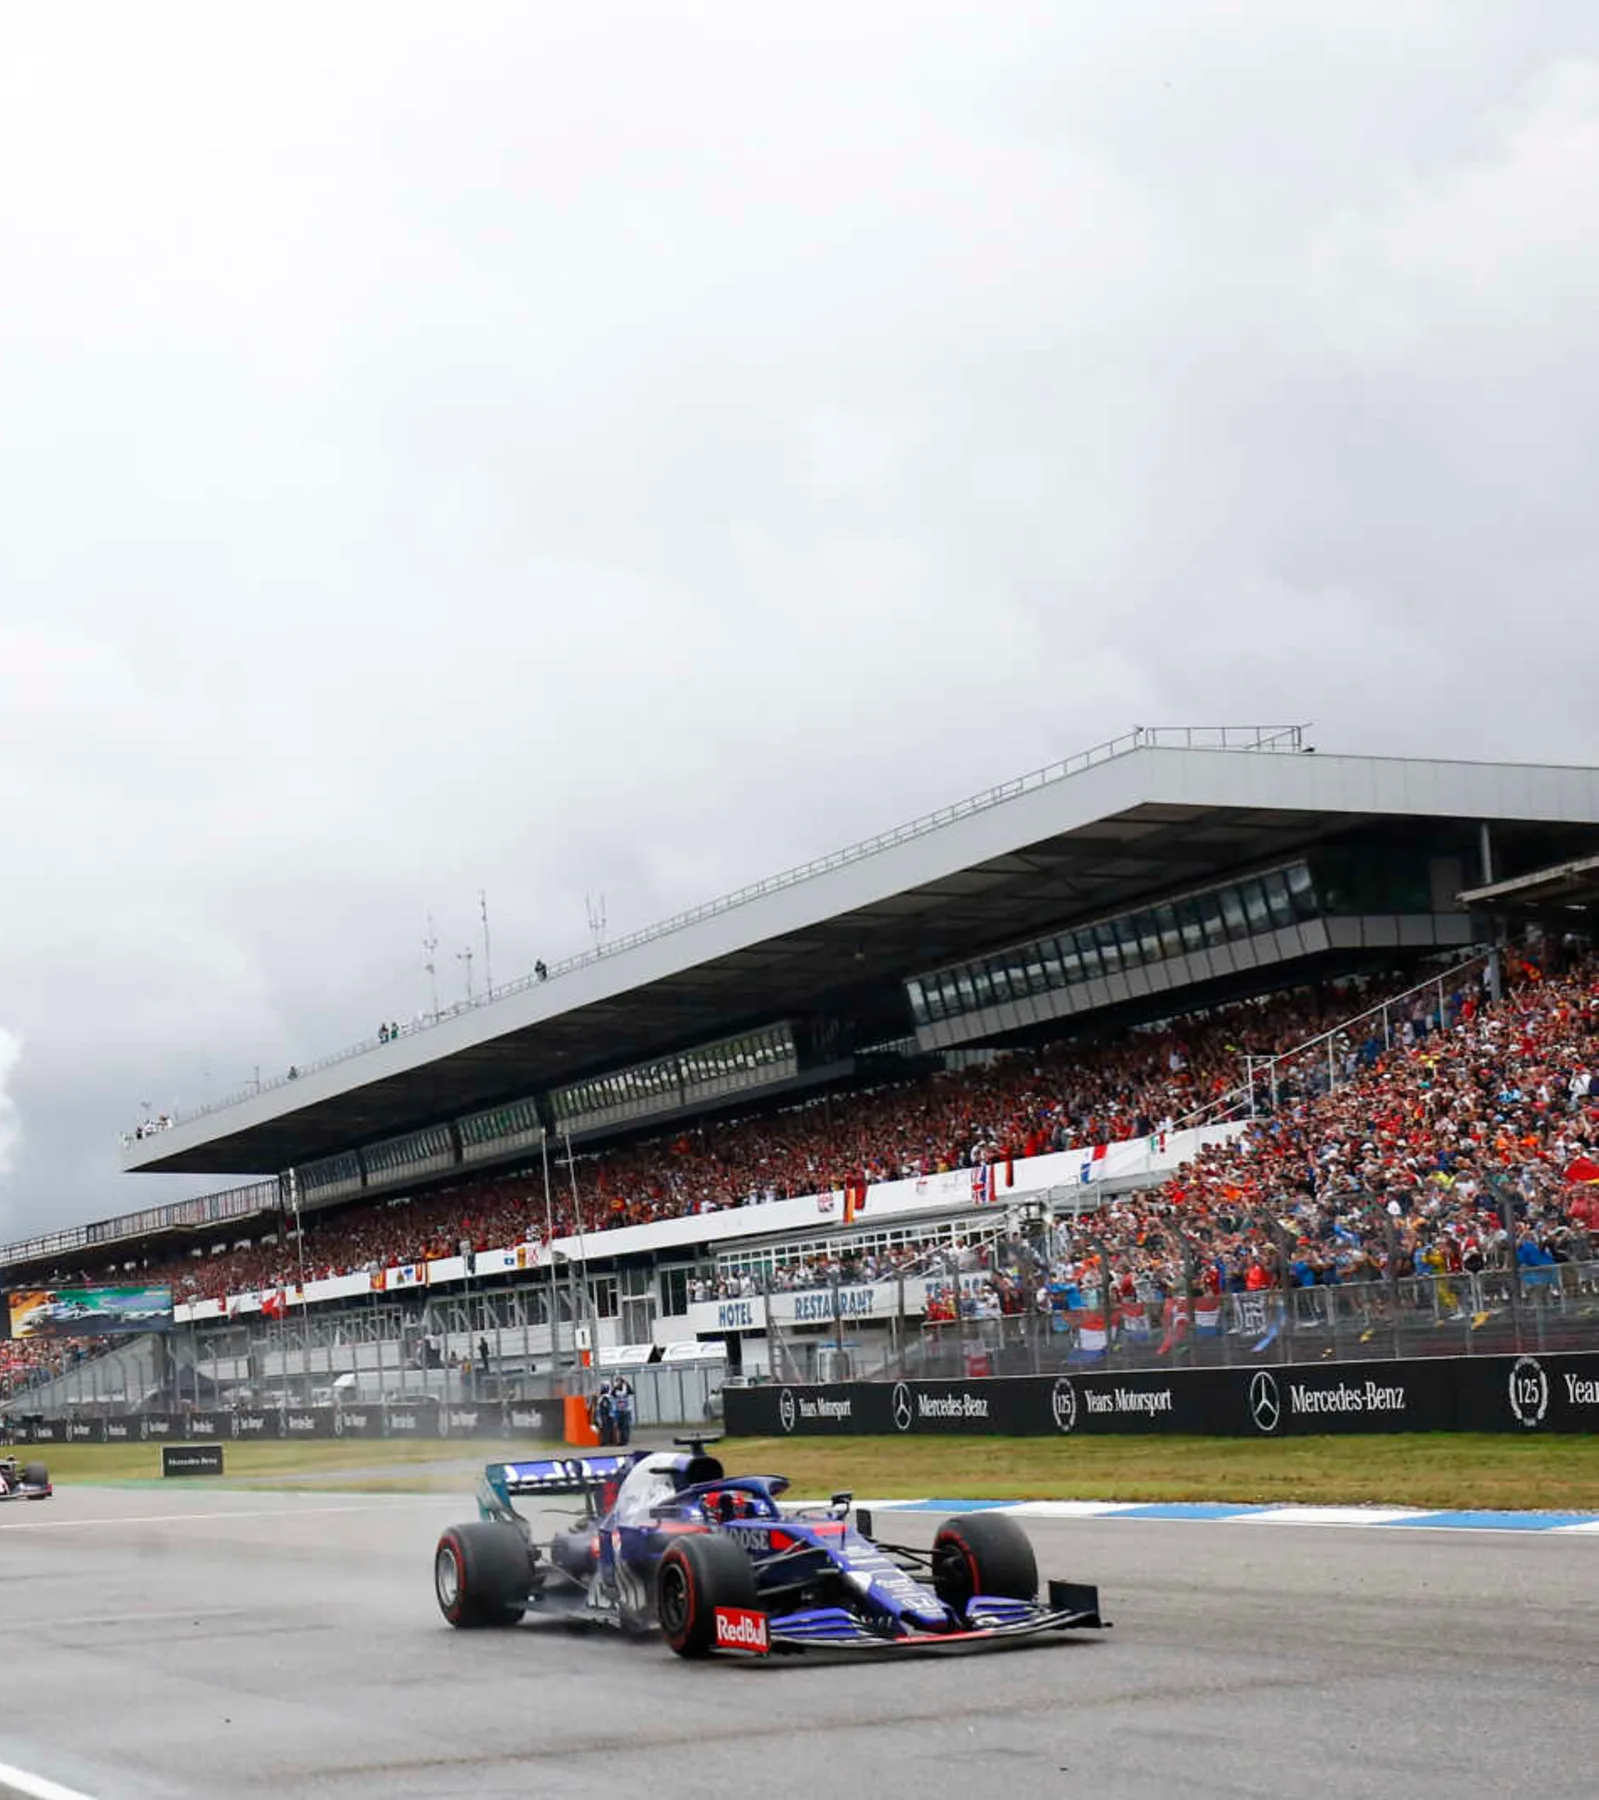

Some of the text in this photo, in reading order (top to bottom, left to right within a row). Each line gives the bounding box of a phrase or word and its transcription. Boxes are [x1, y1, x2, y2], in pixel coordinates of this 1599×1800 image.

[719, 1301, 753, 1327] HOTEL
[1290, 1381, 1405, 1414] Mercedes-Benz
[1517, 1378, 1540, 1404] 125
[1563, 1373, 1599, 1404] Year
[799, 1397, 852, 1421] Years Motorsport
[918, 1393, 989, 1418] Mercedes-Benz
[1057, 1394, 1071, 1414] 125
[1084, 1388, 1173, 1417] Years Motorsport
